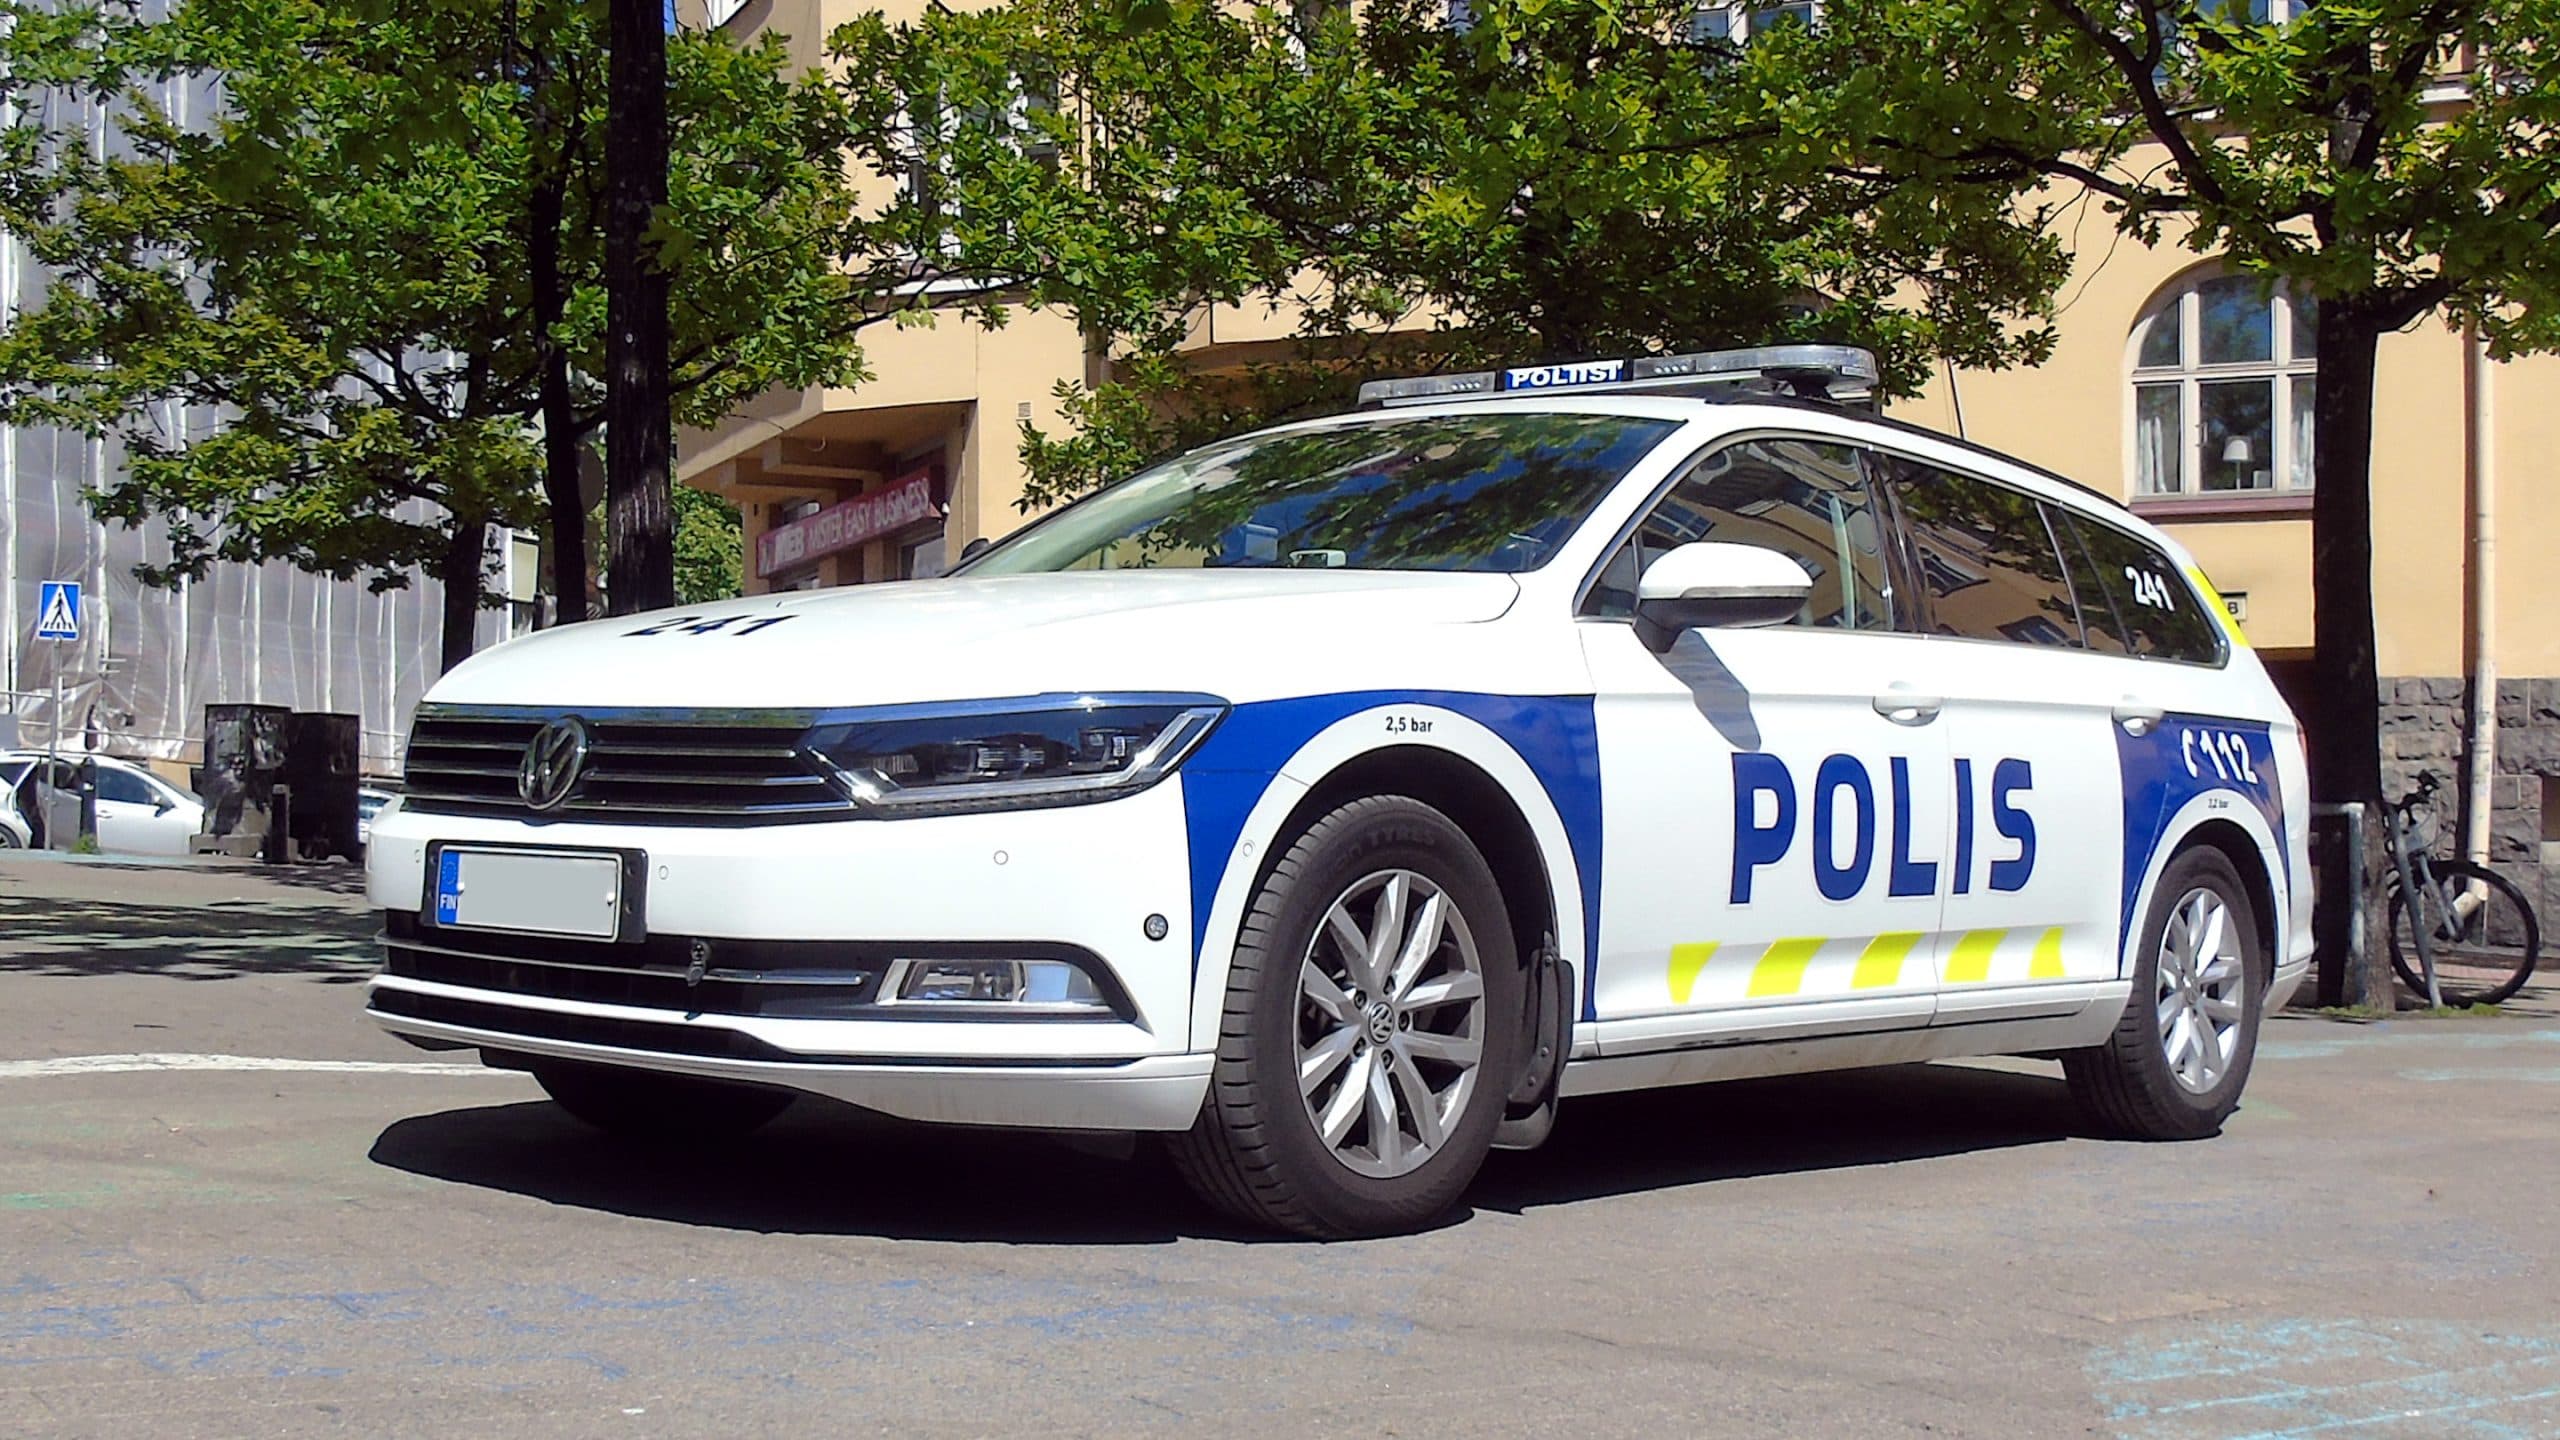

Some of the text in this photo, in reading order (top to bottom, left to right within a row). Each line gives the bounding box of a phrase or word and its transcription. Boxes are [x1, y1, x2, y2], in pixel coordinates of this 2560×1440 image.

[846, 502, 872, 539] EASY
[874, 477, 929, 527] BUSINESS
[2125, 566, 2175, 611] 241
[620, 614, 800, 636] 241
[1386, 716, 1433, 734] 2,5 bar
[2200, 730, 2258, 784] 112
[1729, 751, 2037, 905] POLIS
[439, 894, 457, 909] FIN
